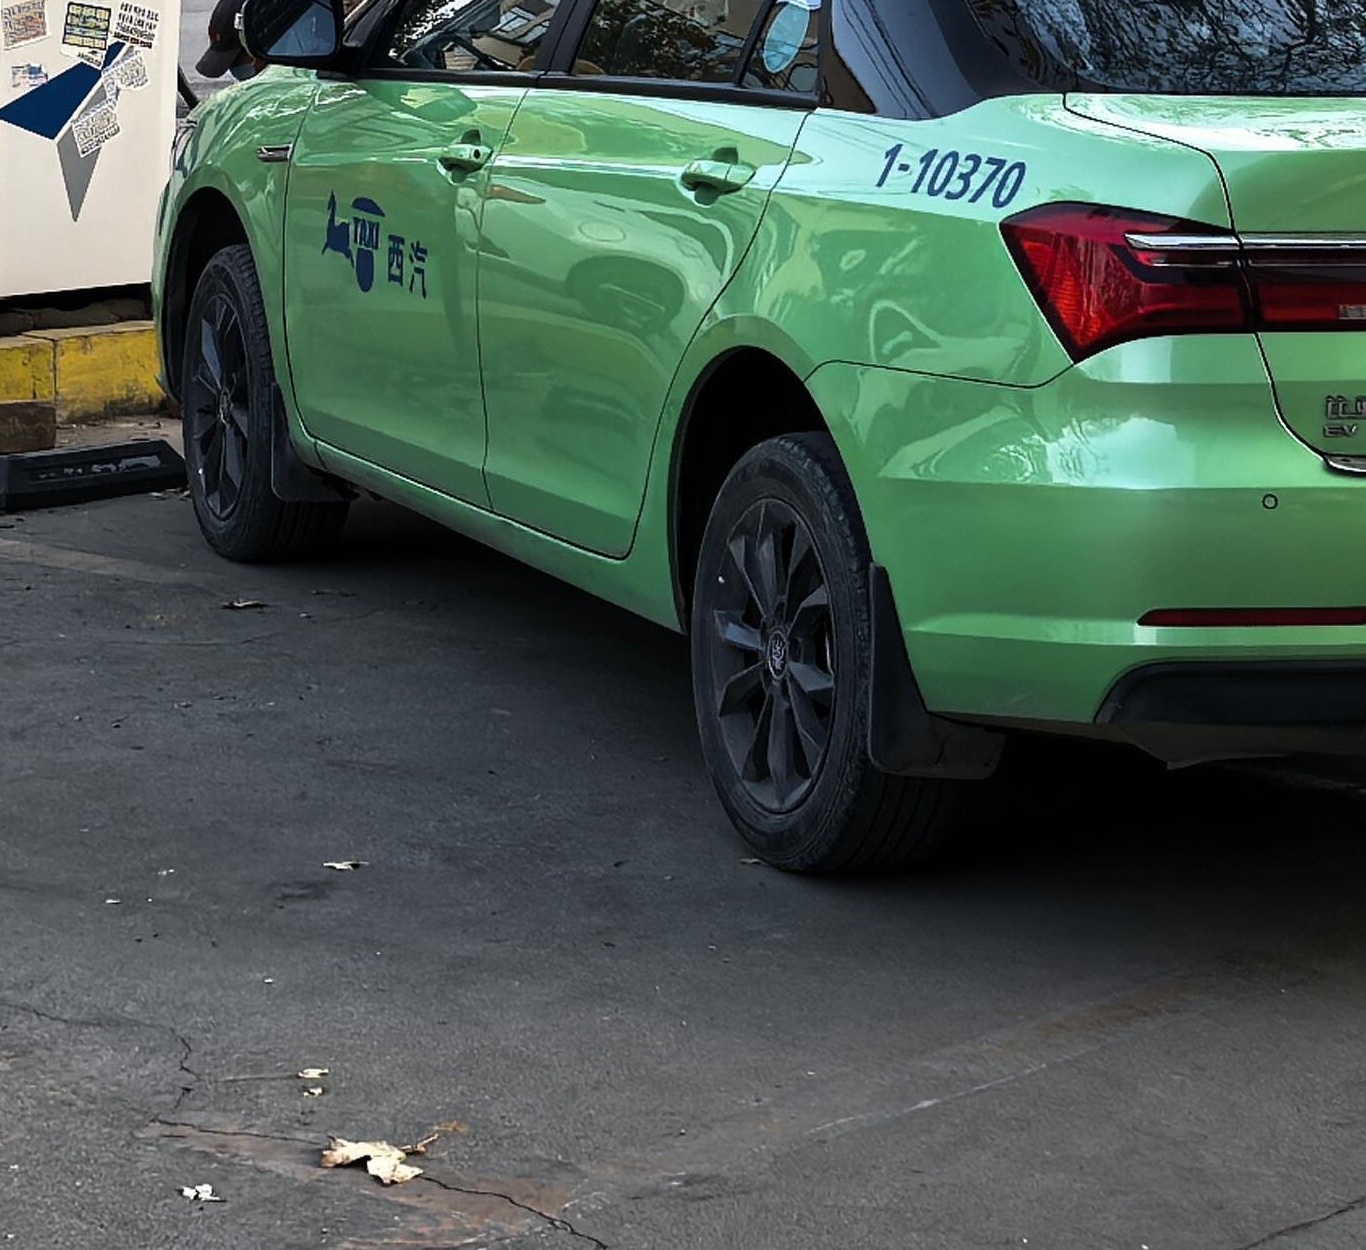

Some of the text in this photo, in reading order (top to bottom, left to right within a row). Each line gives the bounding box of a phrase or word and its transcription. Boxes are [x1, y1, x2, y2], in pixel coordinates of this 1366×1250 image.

[876, 143, 1027, 209] 1-10370
[387, 233, 428, 300] 西汽
[1323, 423, 1358, 437] EV
